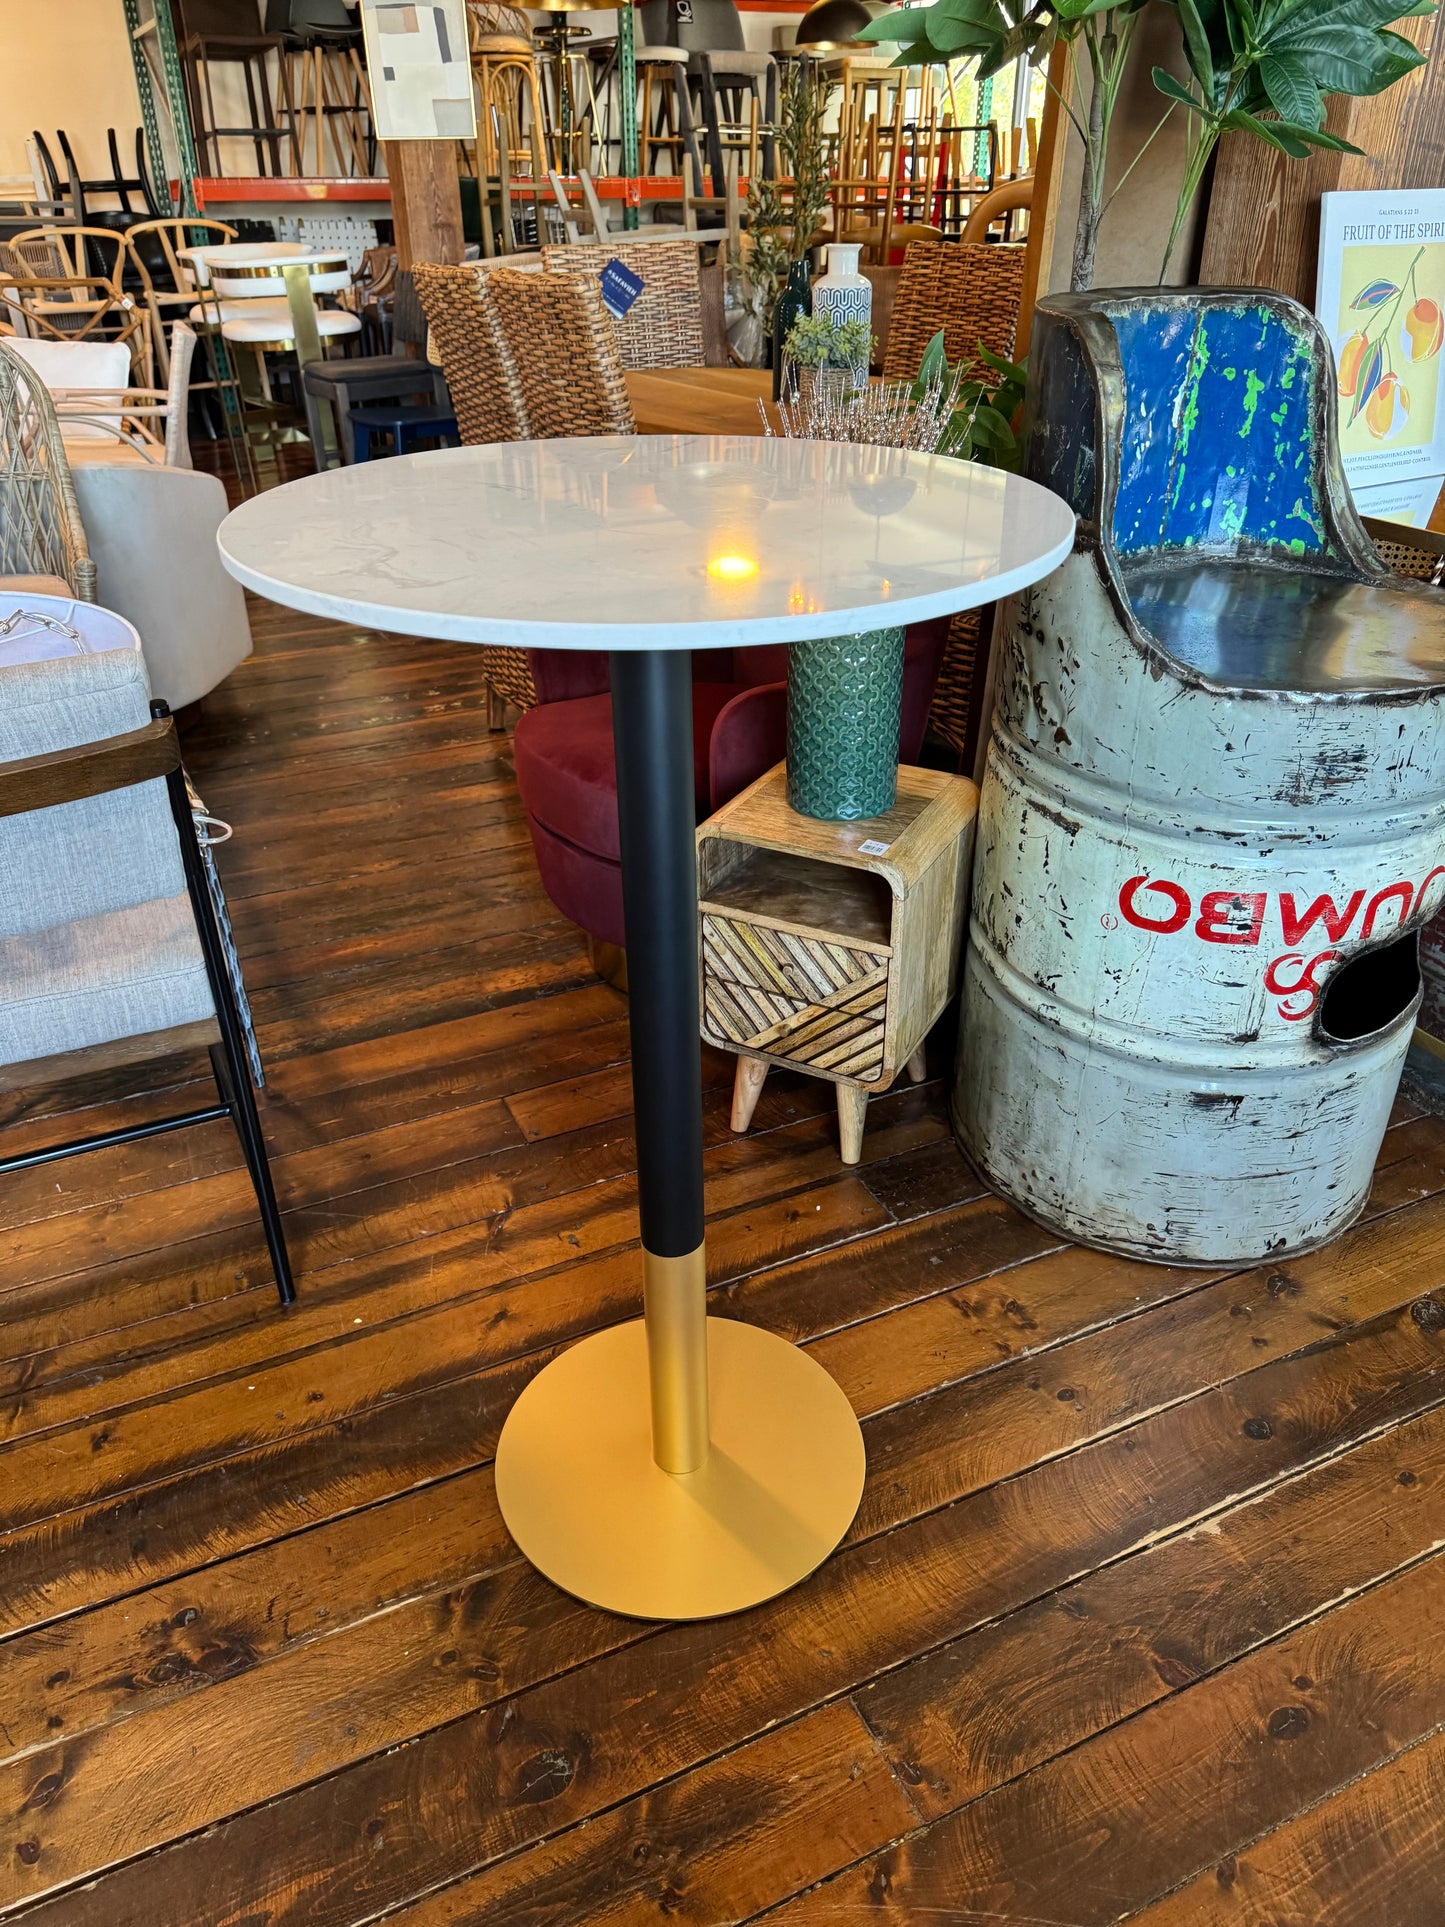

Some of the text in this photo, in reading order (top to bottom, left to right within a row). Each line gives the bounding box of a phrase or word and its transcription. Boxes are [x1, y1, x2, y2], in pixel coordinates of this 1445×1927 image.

[1343, 225, 1376, 241] FRUIT
[1378, 224, 1392, 240] OF
[1394, 223, 1415, 239] THE
